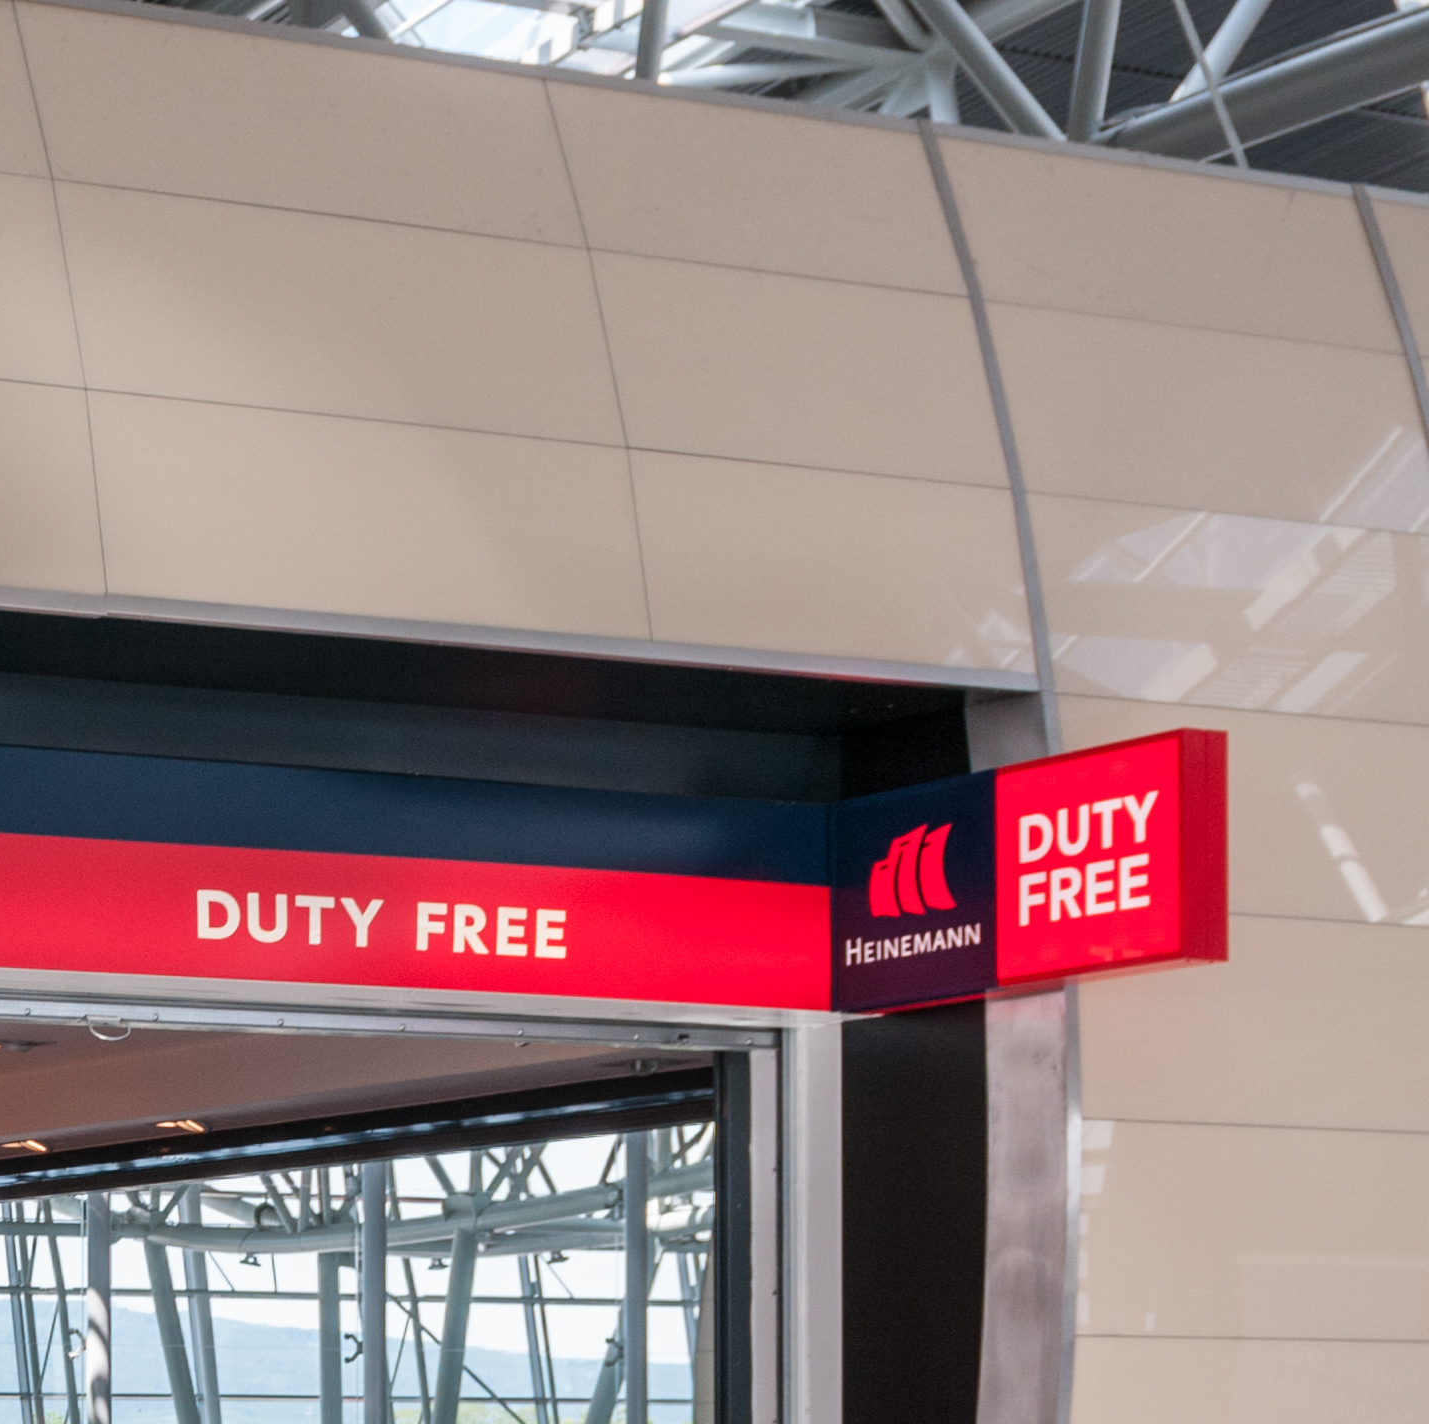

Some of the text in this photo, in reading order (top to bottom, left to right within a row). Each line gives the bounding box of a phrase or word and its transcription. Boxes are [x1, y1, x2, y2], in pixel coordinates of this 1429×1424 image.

[1019, 790, 1160, 865] DUTY
[195, 888, 568, 960] DUTY FREE
[1019, 853, 1151, 927] FREE
[845, 922, 982, 967] HEINEMANN
